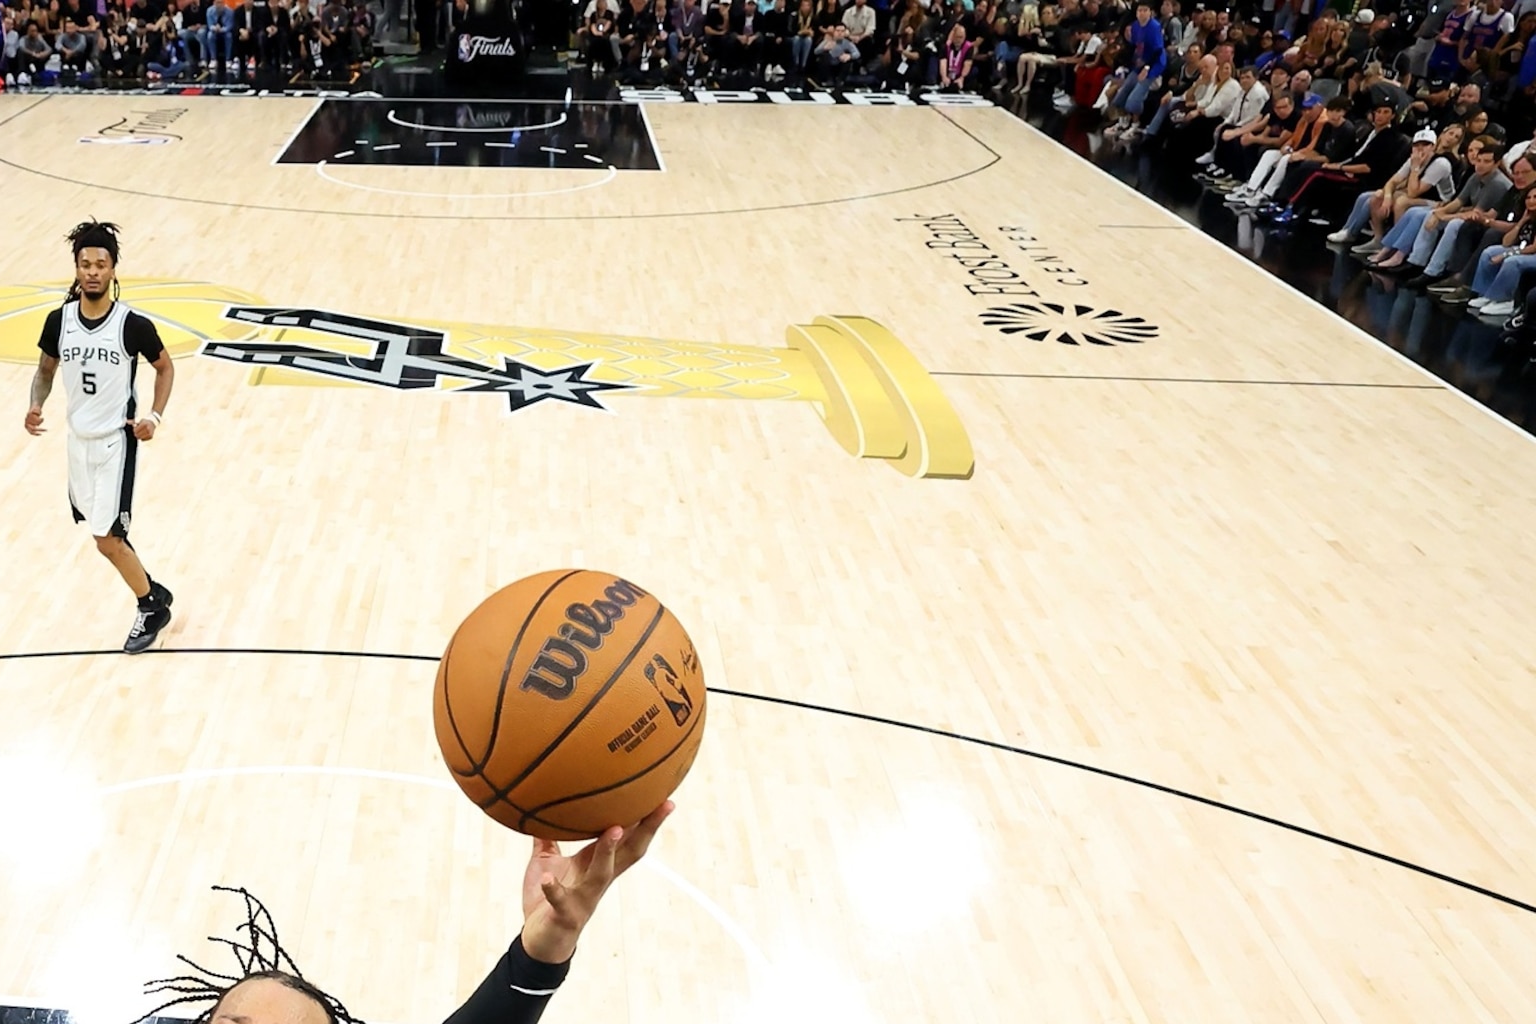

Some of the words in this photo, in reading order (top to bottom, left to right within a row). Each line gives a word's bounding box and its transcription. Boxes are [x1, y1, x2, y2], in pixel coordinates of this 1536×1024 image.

[465, 36, 516, 62] Finals
[620, 90, 995, 107] SPURS
[893, 213, 991, 250] Bank
[998, 226, 1089, 286] CENTER
[943, 254, 1040, 297] Frost
[62, 347, 120, 366] SPURS
[82, 372, 96, 395] 5
[520, 578, 648, 701] Wilson
